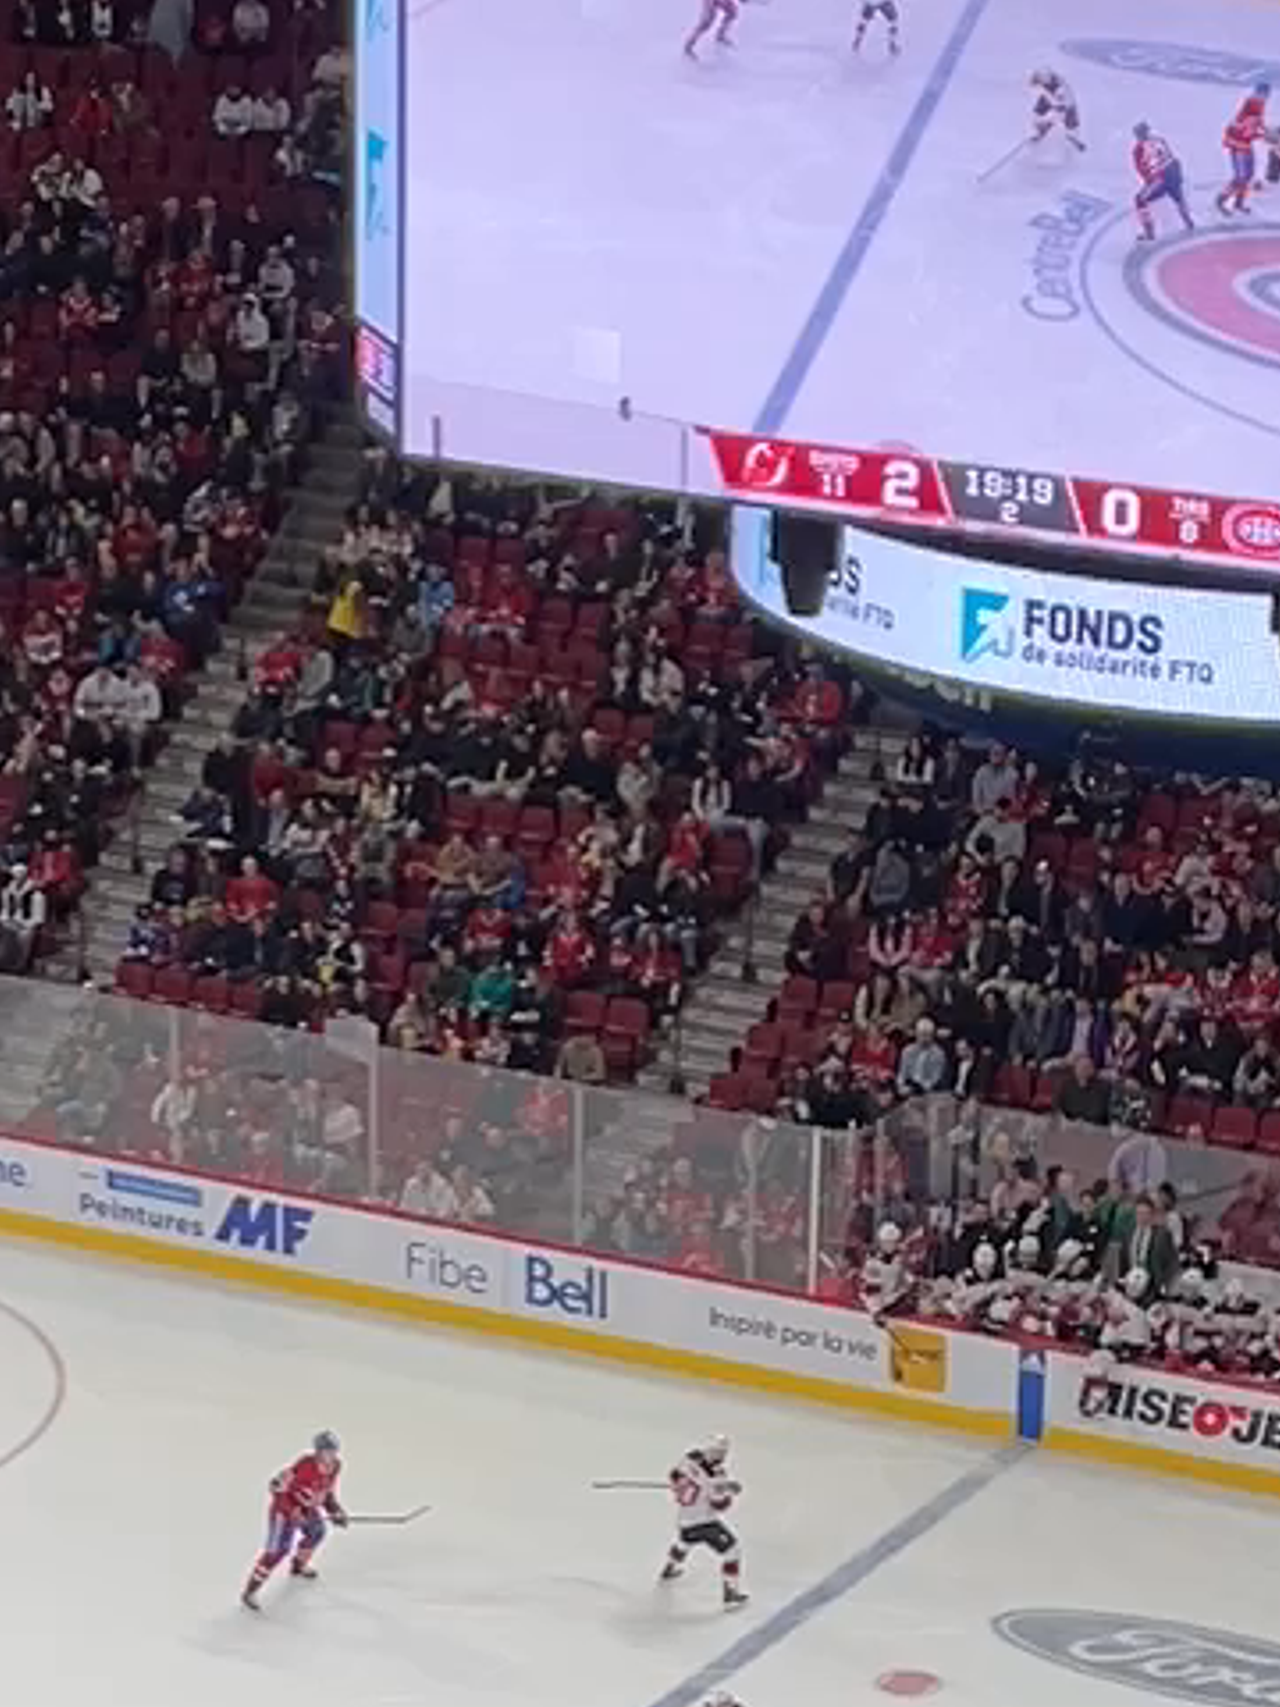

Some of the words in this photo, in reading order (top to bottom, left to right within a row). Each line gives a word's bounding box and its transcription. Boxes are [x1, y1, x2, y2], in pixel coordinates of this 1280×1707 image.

[881, 459, 920, 511] 2
[1000, 501, 1020, 525] 2
[1102, 488, 1142, 537] 0
[1022, 598, 1165, 657] FONDS
[1021, 643, 1050, 667] de
[1054, 646, 1163, 681] solidarité
[1168, 661, 1215, 687] FTQ
[79, 1193, 205, 1241] Peintures
[213, 1195, 316, 1258] MF
[406, 1242, 489, 1295] Fibe
[524, 1255, 609, 1322] Bell
[709, 1303, 776, 1348] Inspiré
[781, 1326, 816, 1354] par
[823, 1329, 839, 1353] la
[844, 1333, 878, 1361] vie
